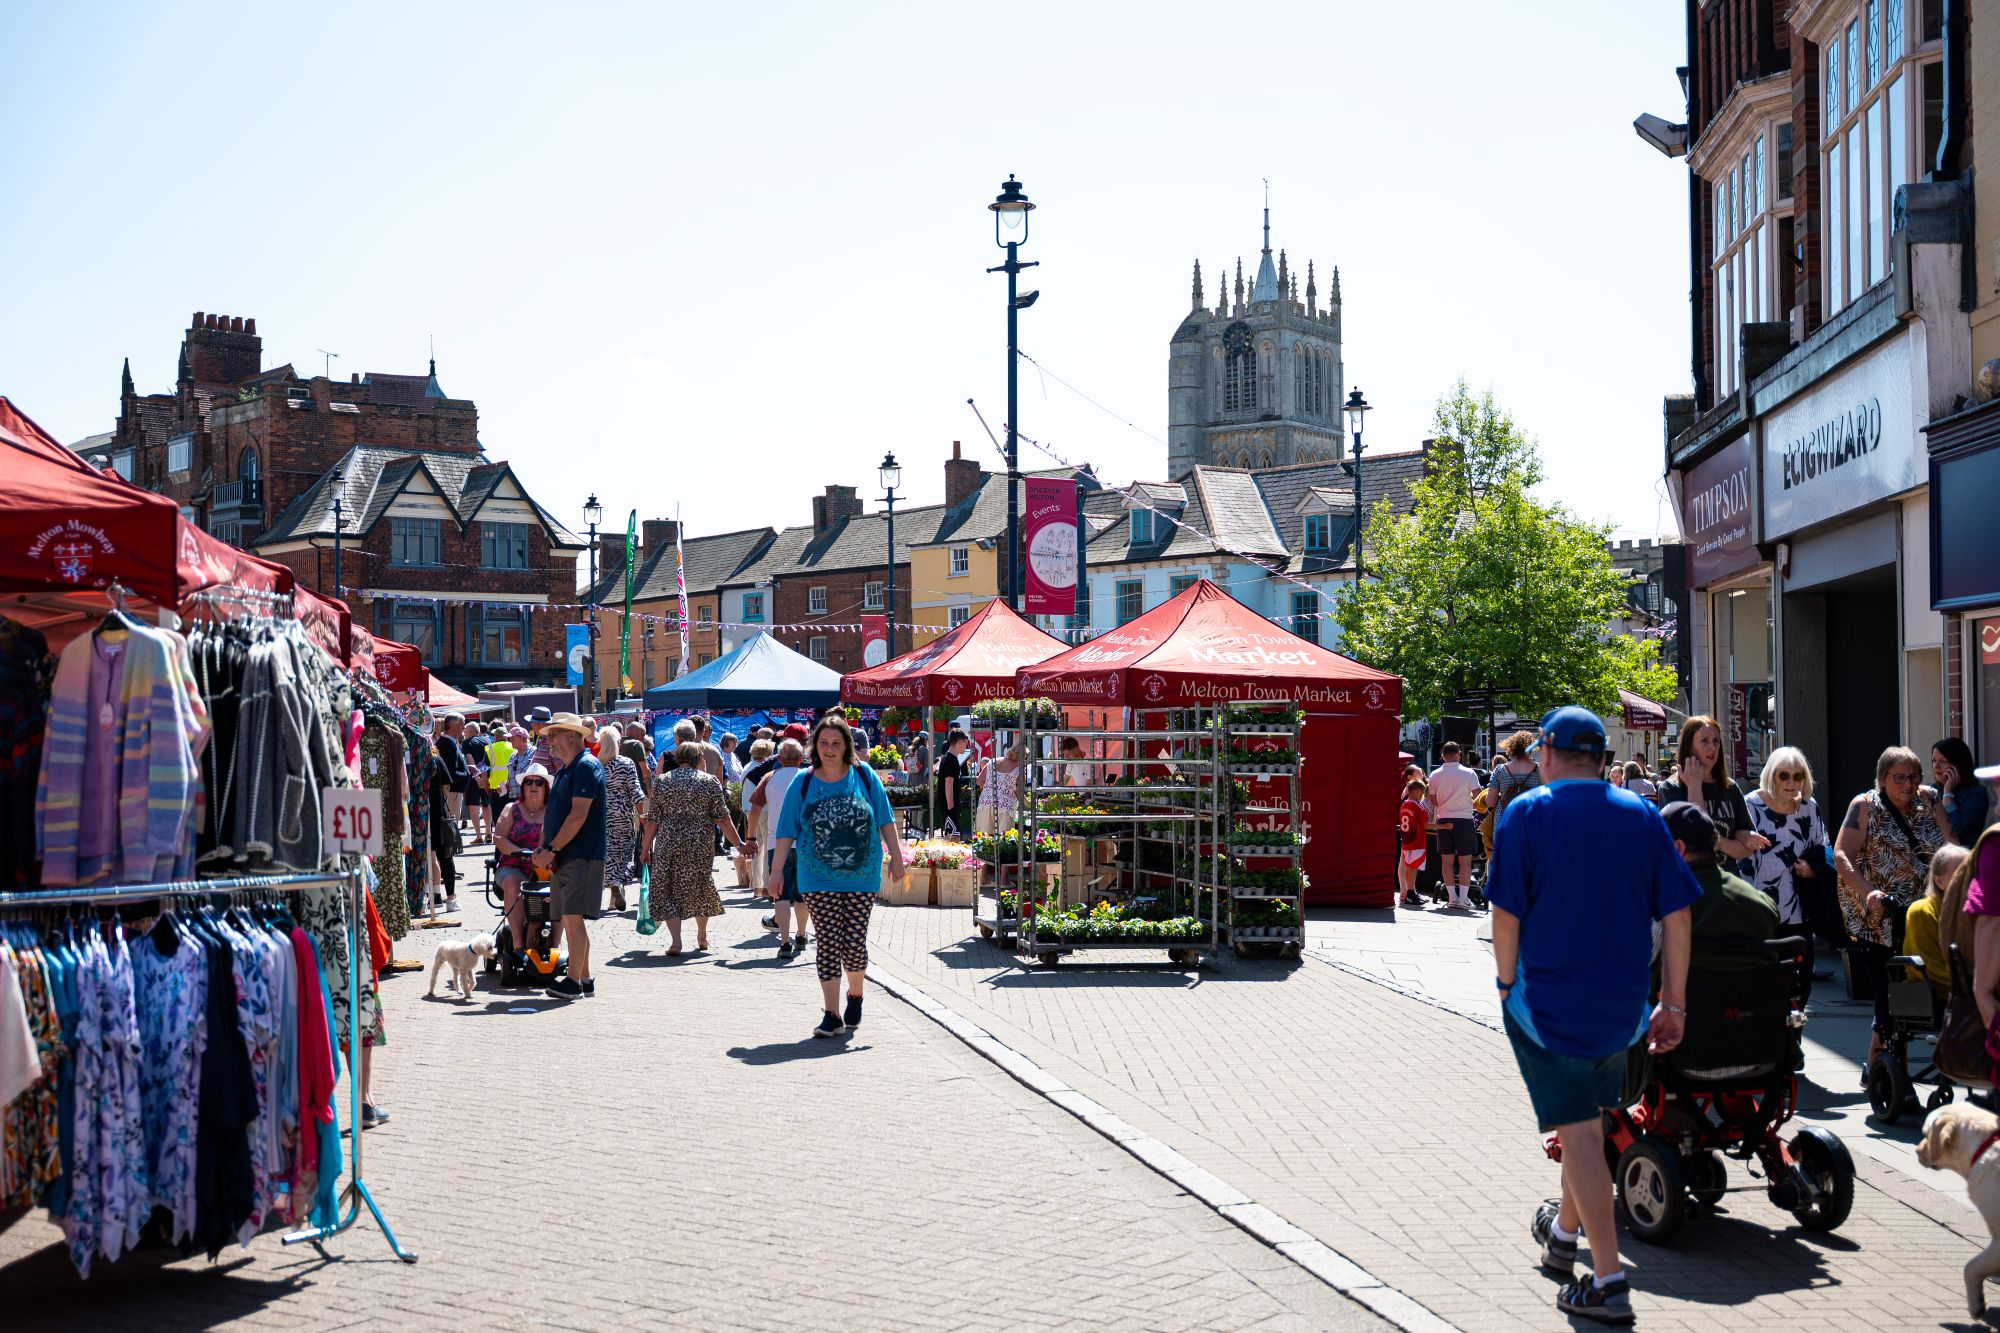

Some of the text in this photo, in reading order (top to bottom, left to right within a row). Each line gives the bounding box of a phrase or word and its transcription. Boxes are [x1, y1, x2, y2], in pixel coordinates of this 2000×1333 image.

[1783, 398, 1881, 490] ECIGWIZARD
[1693, 467, 1748, 534] TIMPSON
[1032, 505, 1060, 519] Events
[28, 519, 115, 559] Melton Mowbray
[1718, 537, 1723, 549] By
[1181, 634, 1300, 646] Melton Town
[1188, 646, 1317, 666] Market
[876, 683, 891, 697] Town
[891, 682, 913, 697] Market
[974, 683, 1015, 697] Melto
[1056, 677, 1077, 693] Town
[1077, 677, 1104, 694] Market
[1180, 681, 1352, 703] Melton Town Market
[1728, 684, 1742, 742] CAR KEY
[333, 805, 372, 840] £10
[1400, 815, 1409, 832] 8
